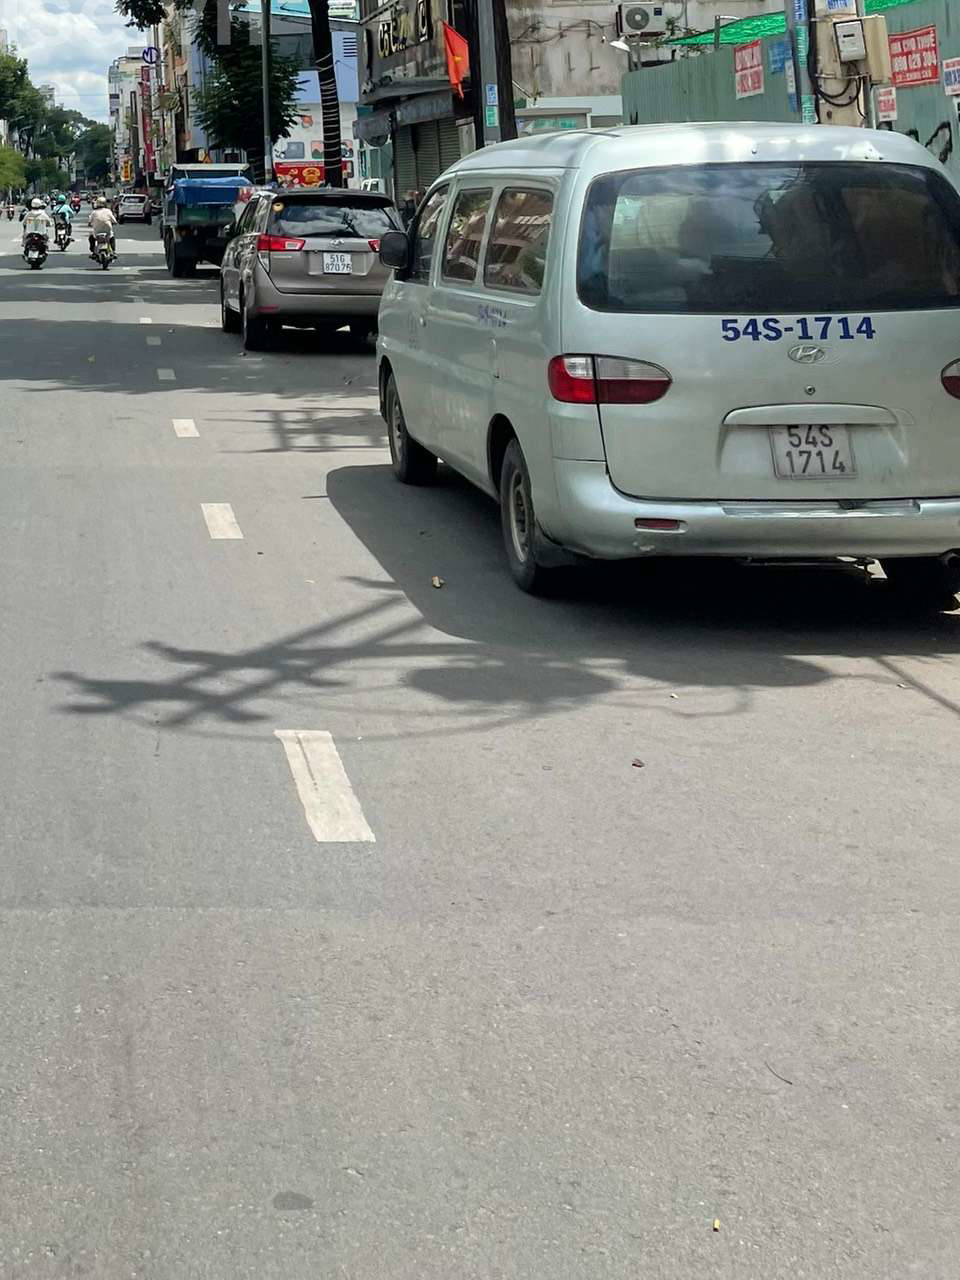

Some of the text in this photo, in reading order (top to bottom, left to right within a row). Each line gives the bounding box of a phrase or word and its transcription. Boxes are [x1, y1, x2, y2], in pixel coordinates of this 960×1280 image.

[721, 316, 876, 342] 54S-1714
[787, 424, 834, 448] 54S
[785, 450, 846, 474] 1714
